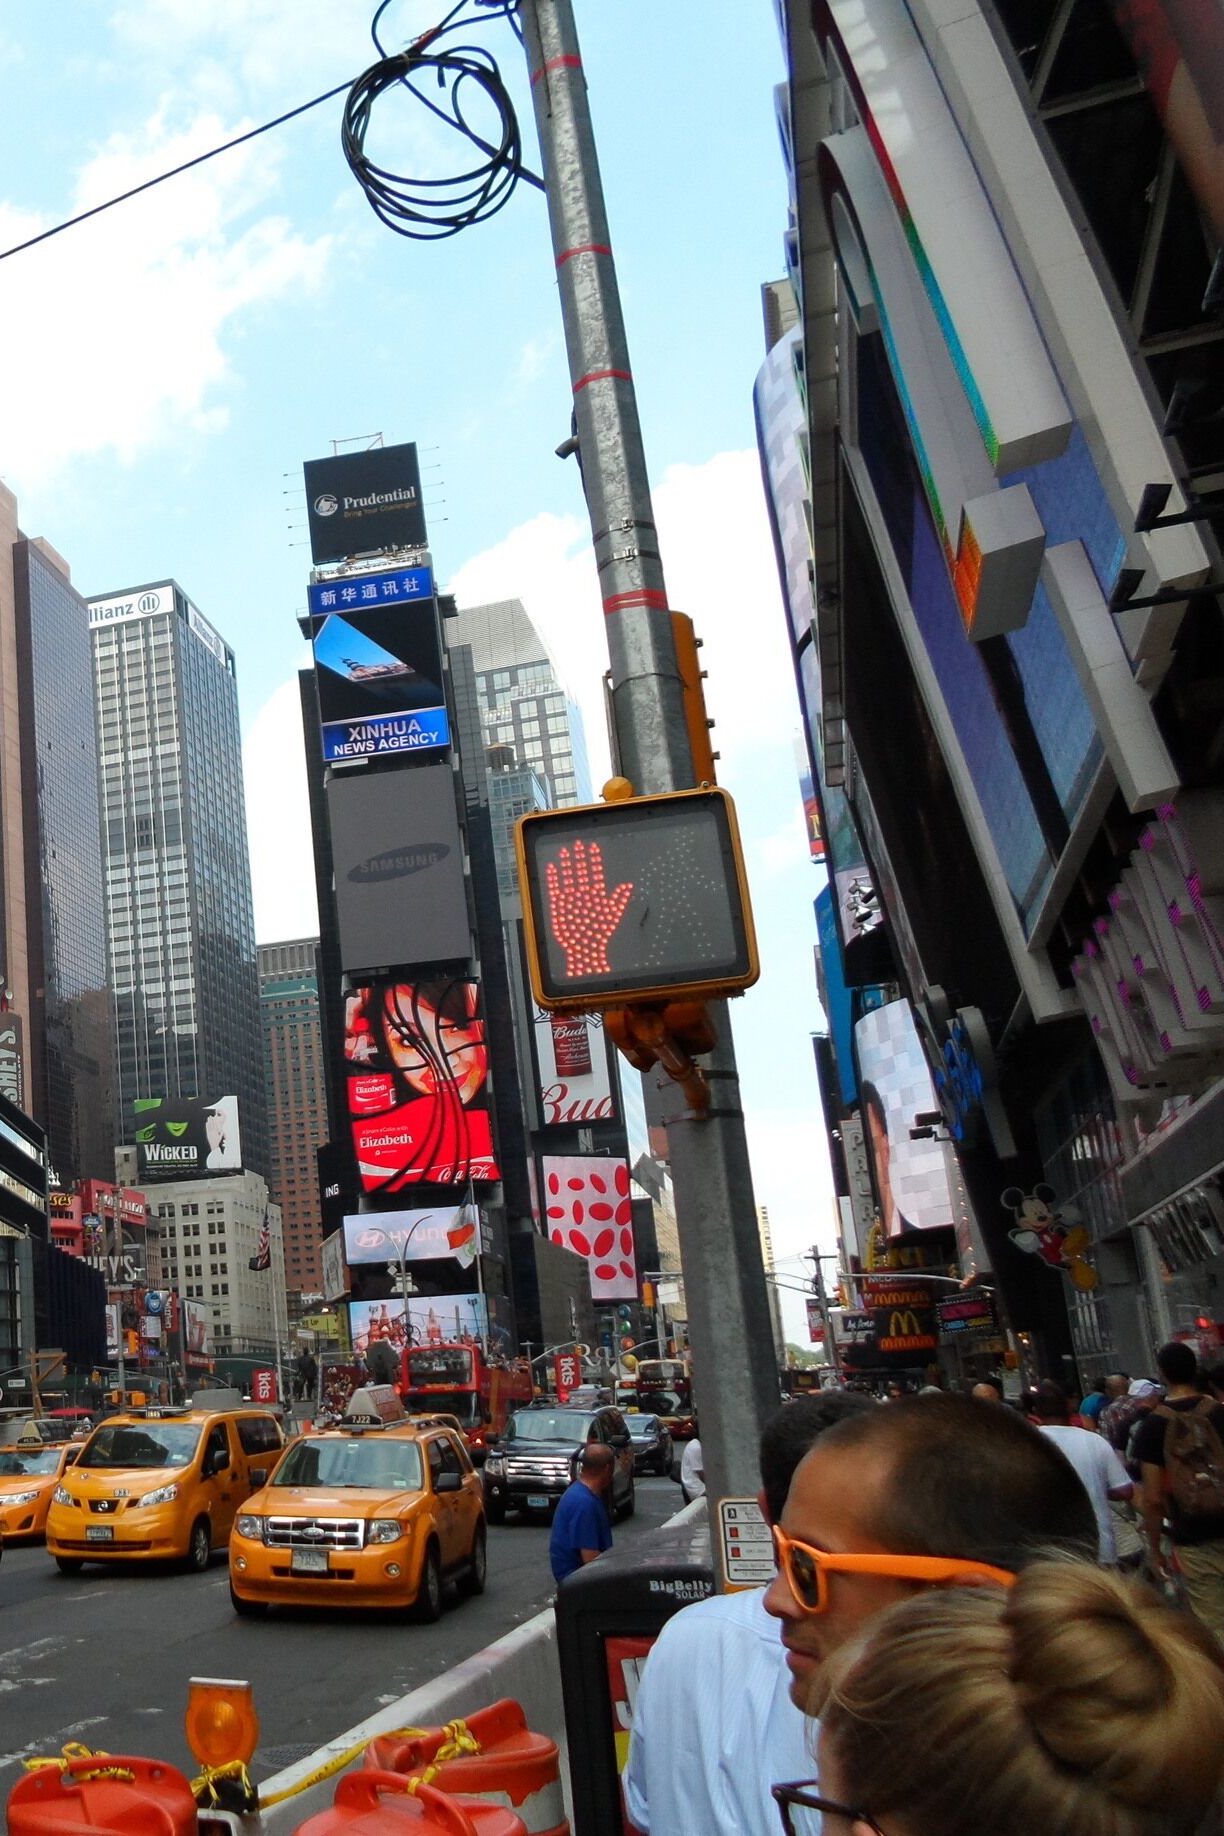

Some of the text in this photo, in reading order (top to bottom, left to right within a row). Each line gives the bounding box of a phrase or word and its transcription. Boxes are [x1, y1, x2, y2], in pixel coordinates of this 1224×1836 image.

[343, 486, 417, 510] Prudential
[319, 576, 421, 607] 新华通讯社
[88, 602, 135, 624] llianz
[347, 718, 422, 743] XINHUA
[333, 731, 440, 756] NEWS AGENCY
[359, 853, 438, 875] SAMSUNG
[354, 1084, 388, 1095] Elizabeth
[359, 1133, 414, 1149] Elizabeth
[389, 1227, 447, 1245] HYUND
[560, 1356, 574, 1386] tkts
[258, 1371, 271, 1399] tkts
[351, 1414, 371, 1425] 7J22
[649, 1579, 713, 1594] BigBelly
[674, 1589, 707, 1600] SOLAR
